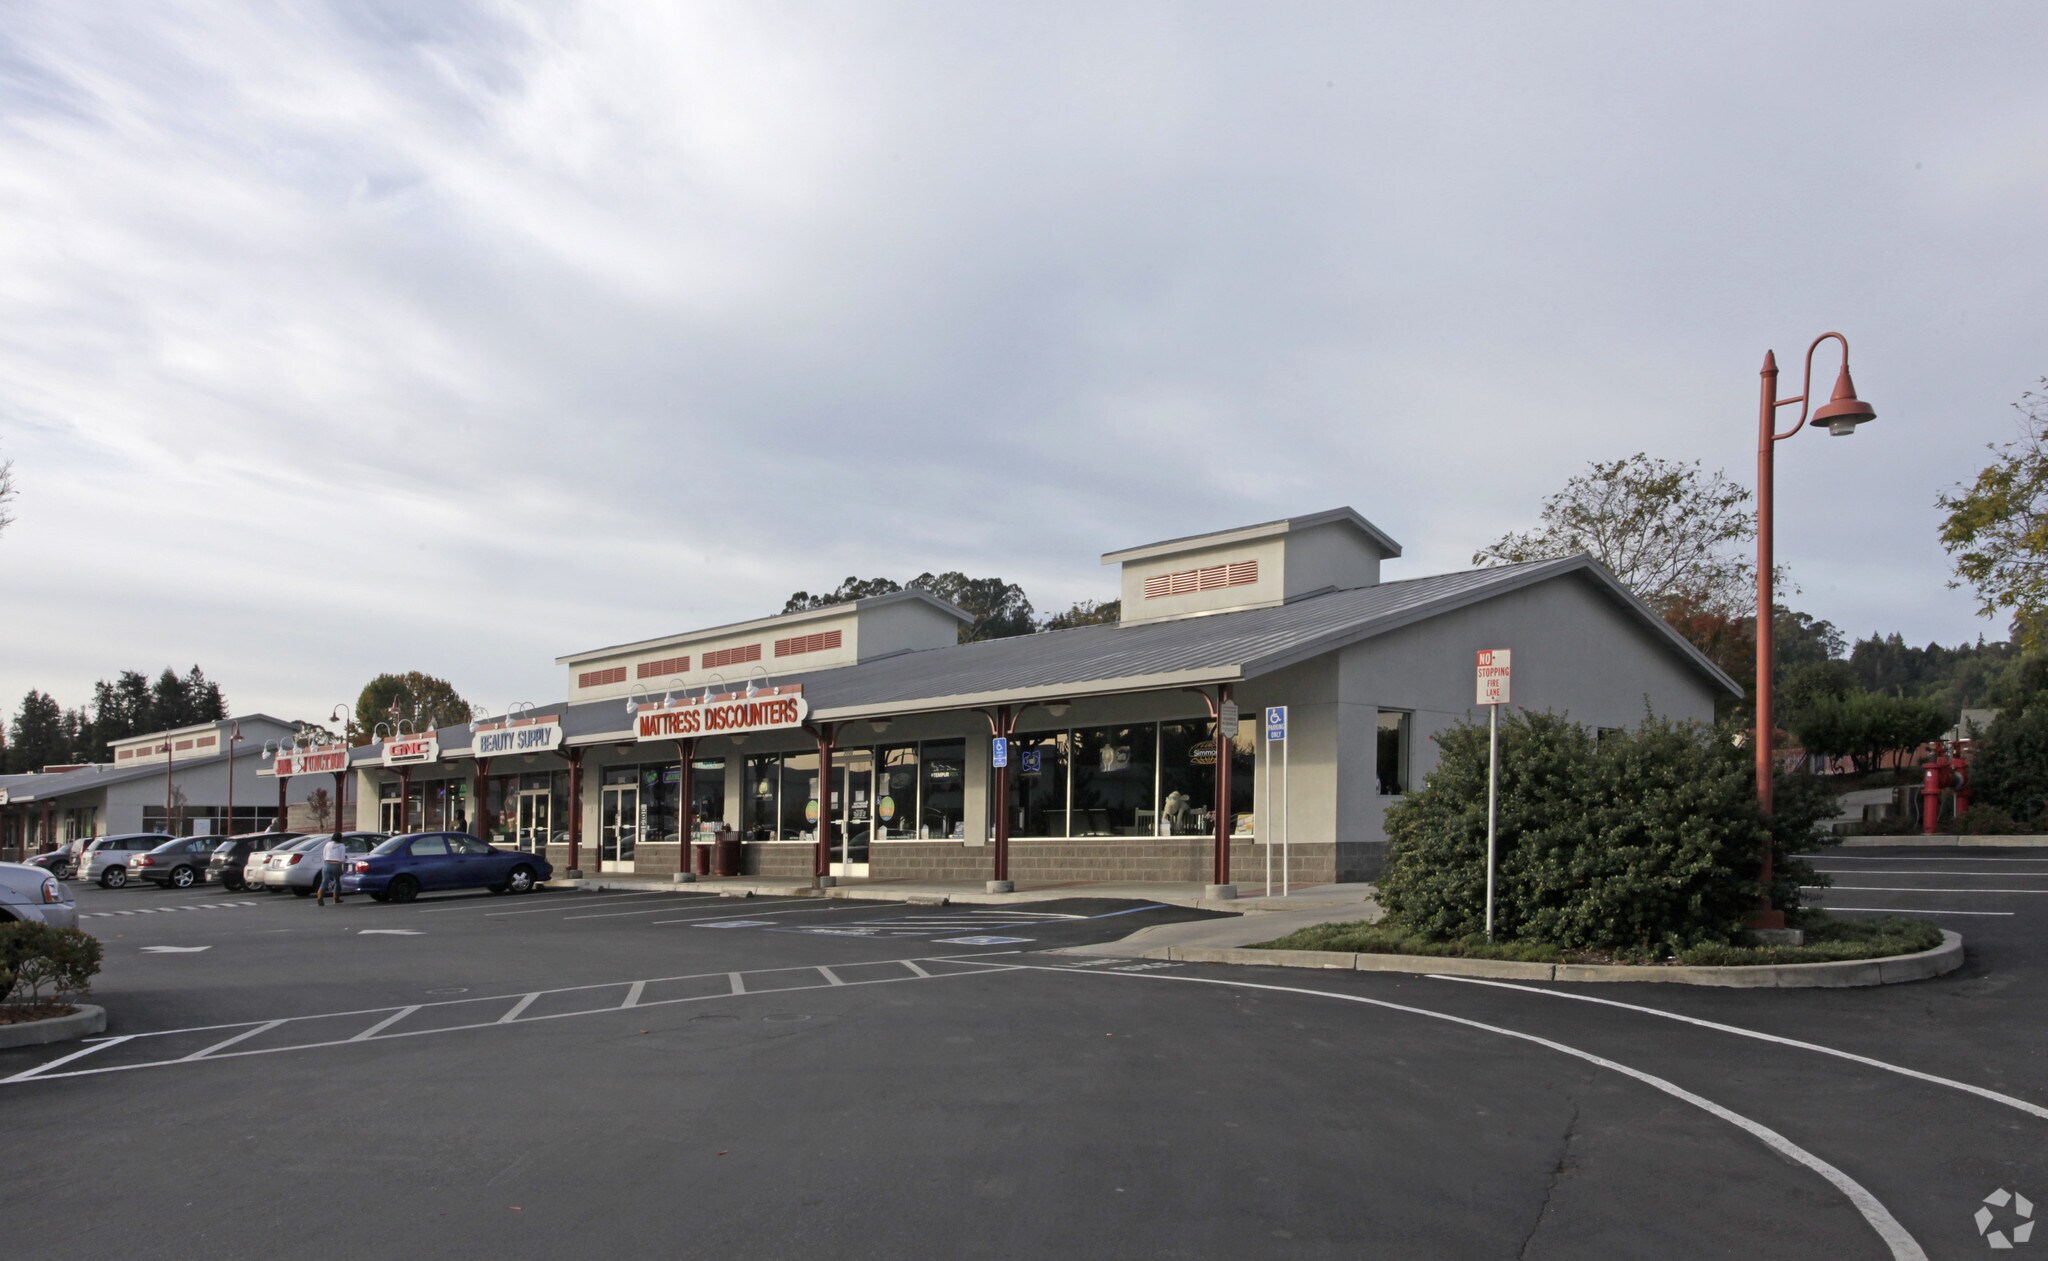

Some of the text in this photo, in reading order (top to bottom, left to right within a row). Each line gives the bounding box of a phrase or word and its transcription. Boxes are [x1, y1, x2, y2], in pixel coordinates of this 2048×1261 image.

[1479, 653, 1491, 665] NO
[1478, 666, 1510, 678] STOPPING
[1487, 679, 1500, 687] FIRE
[1486, 688, 1500, 697] LANE
[639, 697, 797, 737] MATTRESS DISCOUNTERS
[480, 727, 552, 753] BEAUTY SUPPLY
[389, 741, 430, 757] GNC
[1193, 749, 1217, 757] Simmo
[302, 752, 345, 773] JUNCTION
